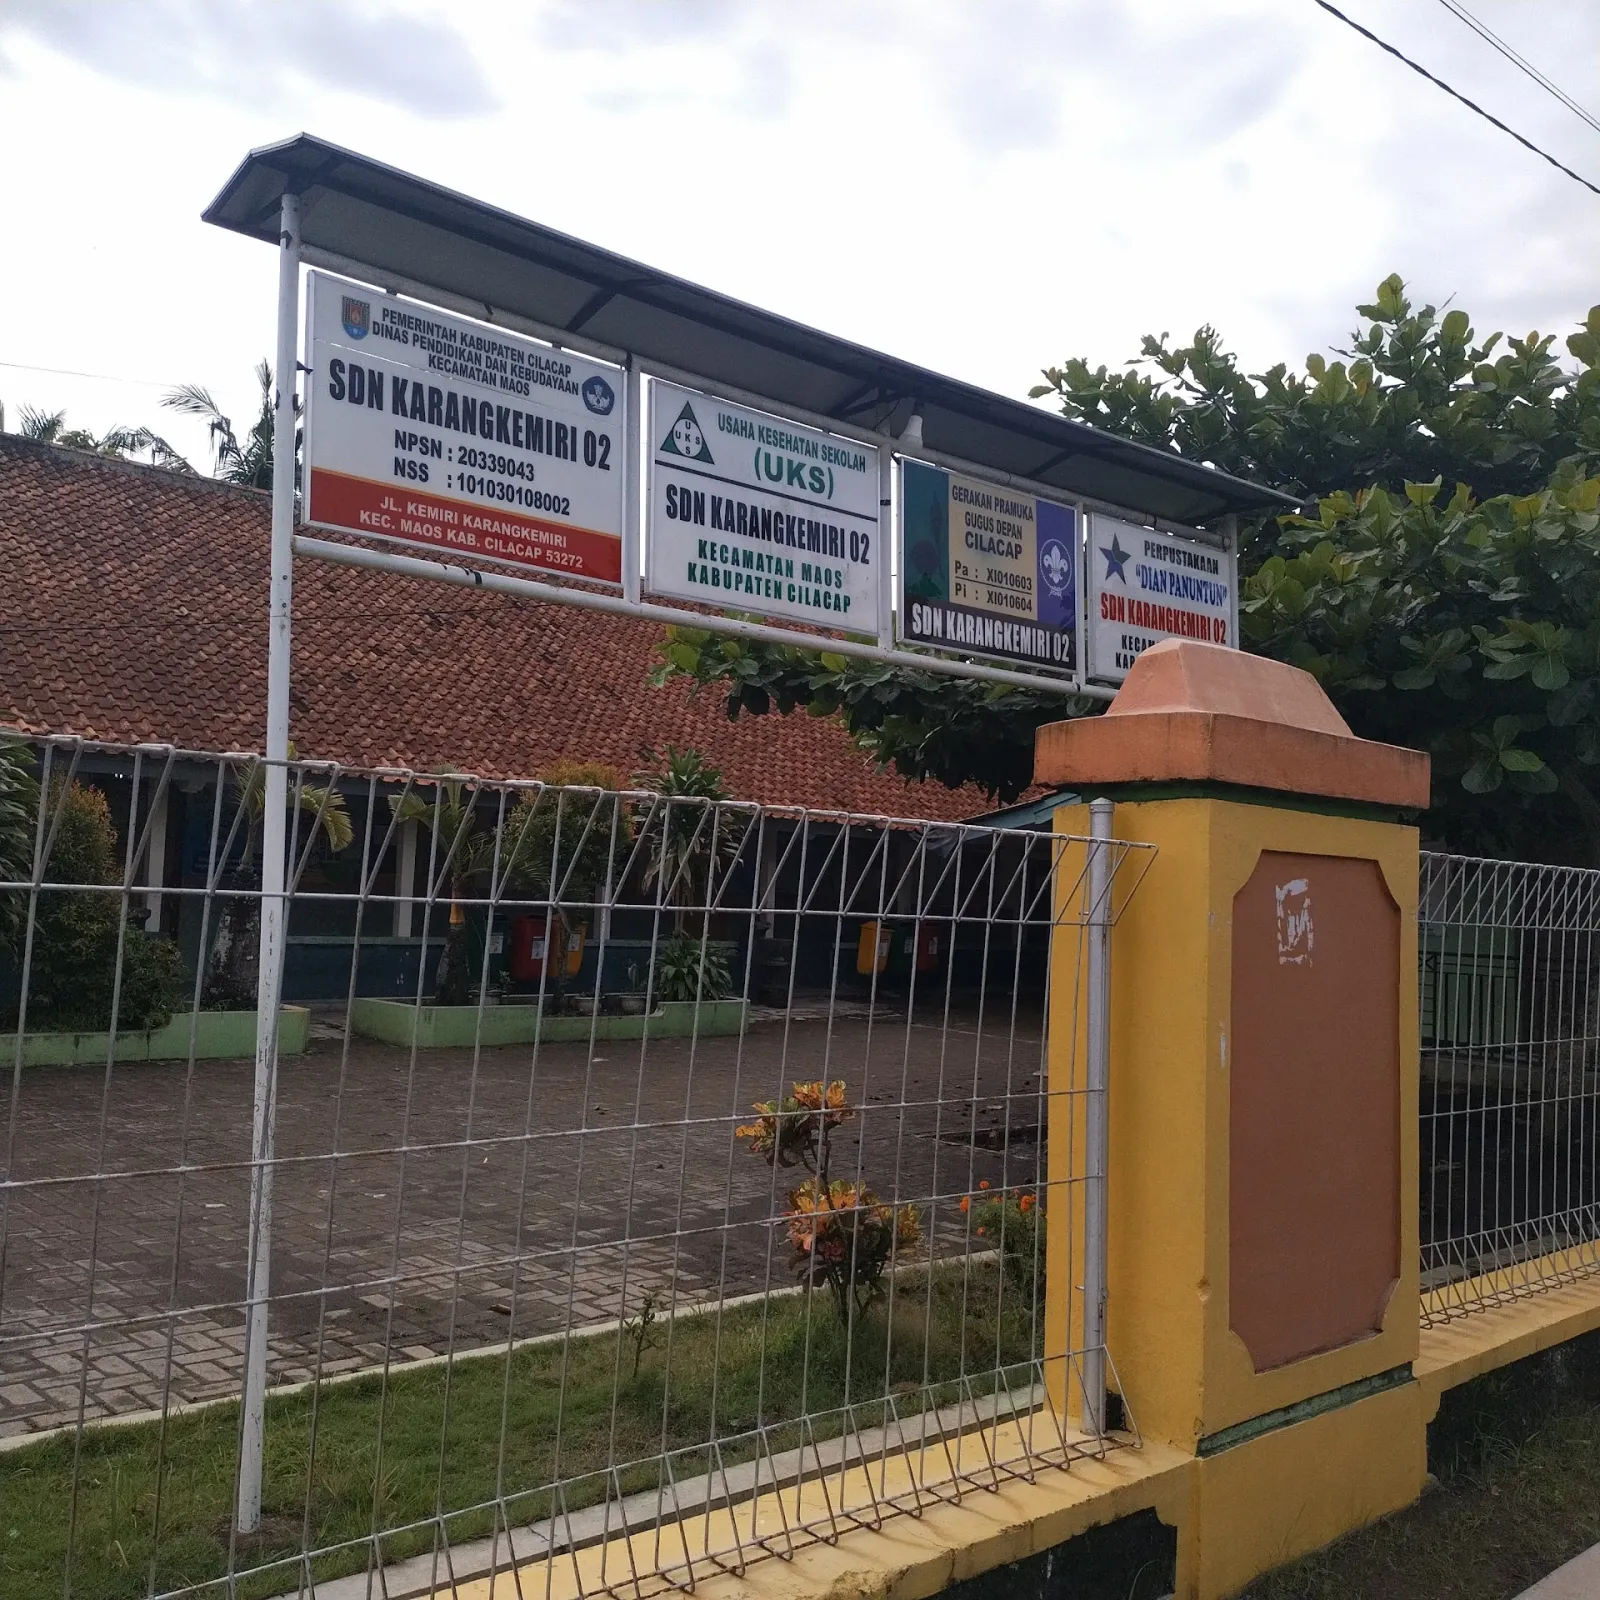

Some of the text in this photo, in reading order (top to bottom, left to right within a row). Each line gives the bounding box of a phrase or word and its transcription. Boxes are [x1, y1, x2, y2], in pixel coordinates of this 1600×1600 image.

[372, 321, 578, 395] DINAS PENDIDIKAN DAN KEBUDAYAAN
[382, 308, 572, 378] PEMERINTAH KABUPATEN CILACAP
[428, 354, 530, 396] KECAMATAN MAOS
[330, 358, 610, 470] SDN KARANGKEMIRI 02
[394, 430, 442, 458] NPSN
[458, 446, 534, 482] 20339043
[718, 412, 866, 473] USAHA KESEHATAN SEKOLAH
[394, 456, 429, 482] NSS
[458, 472, 570, 516] 101030108002
[754, 446, 834, 500] (UKS)
[380, 496, 567, 548] JL. KEMIRI KARANGKEMIRI
[666, 484, 870, 564] SDN KARANGKEMIRI 02
[952, 484, 1034, 522] GERAKAN PRAMUKA
[965, 512, 1022, 540] GUGUS DEPAN
[360, 510, 584, 568] KEC. MAOS KAB. CILACAP 53272
[698, 539, 842, 588] KECAMATAN MAOS
[965, 532, 1022, 560] CILACAP
[1144, 540, 1218, 575] PERPUSTAKAAN
[688, 562, 851, 613] KABUPATEN CILACAP
[955, 560, 968, 576] Pa
[987, 568, 1032, 591] XI010603
[955, 582, 966, 598] Pi
[987, 589, 1032, 612] XI010604
[912, 602, 1070, 662] SDN KARANGKEMIRI 02
[1101, 592, 1226, 644] SDN KARANGKEMIRI 02
